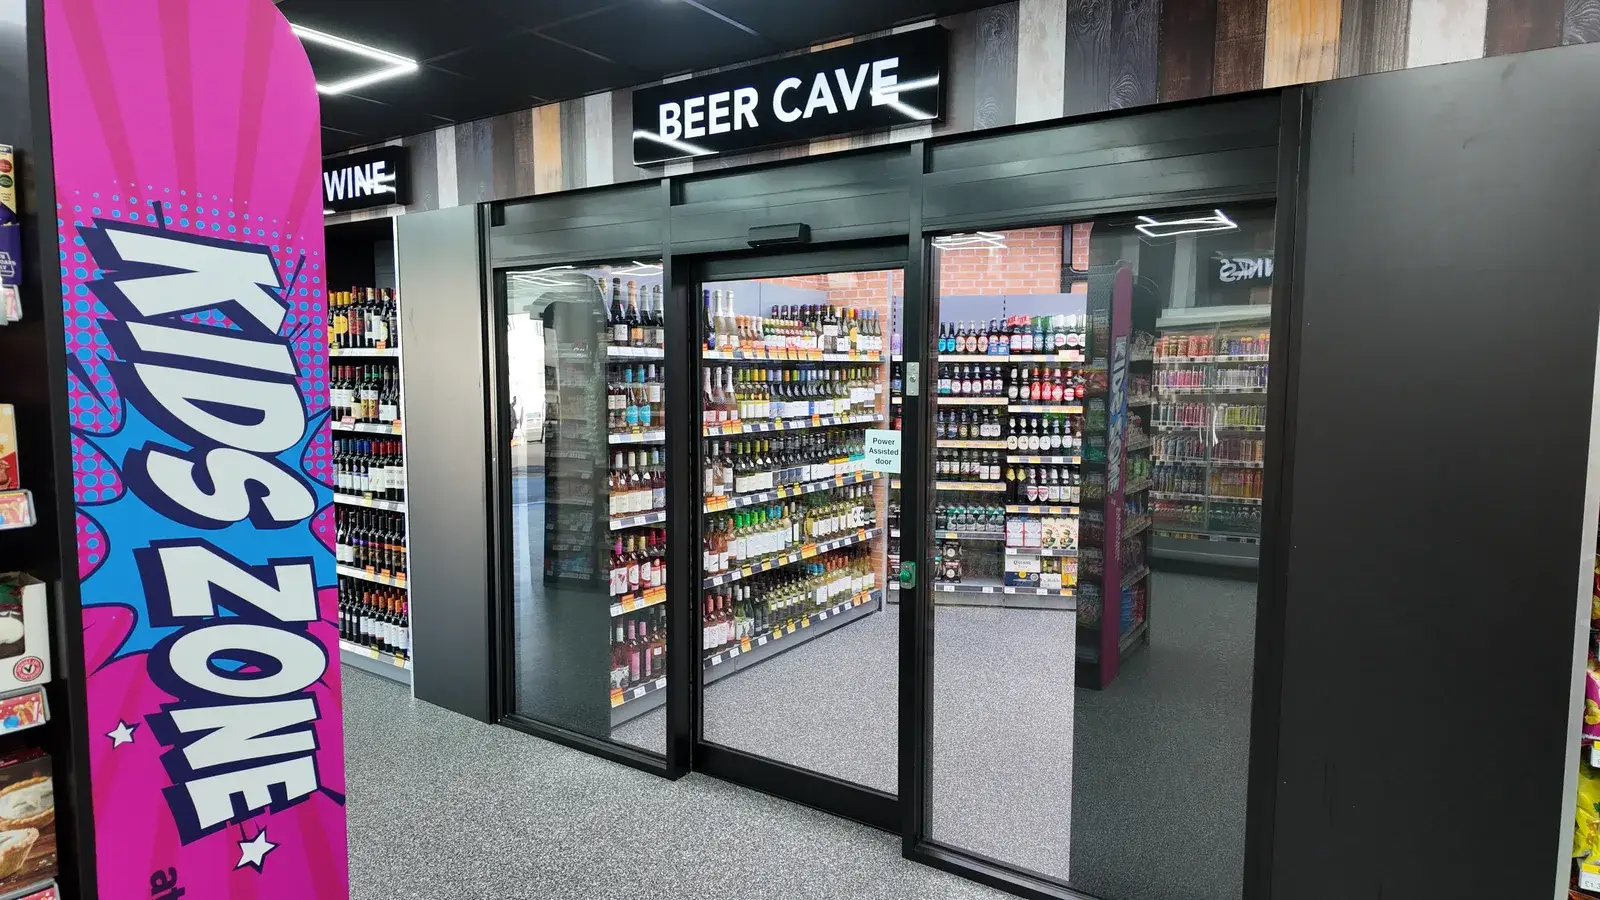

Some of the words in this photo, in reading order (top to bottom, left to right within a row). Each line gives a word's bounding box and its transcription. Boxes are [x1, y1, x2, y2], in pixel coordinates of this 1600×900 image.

[659, 86, 759, 143] BEER
[773, 57, 899, 123] CAVE
[323, 160, 387, 202] WINE
[104, 228, 317, 523] KIDS
[868, 447, 899, 456] Assisted
[872, 437, 895, 446] Power
[875, 458, 892, 466] door
[157, 545, 329, 831] ZONE
